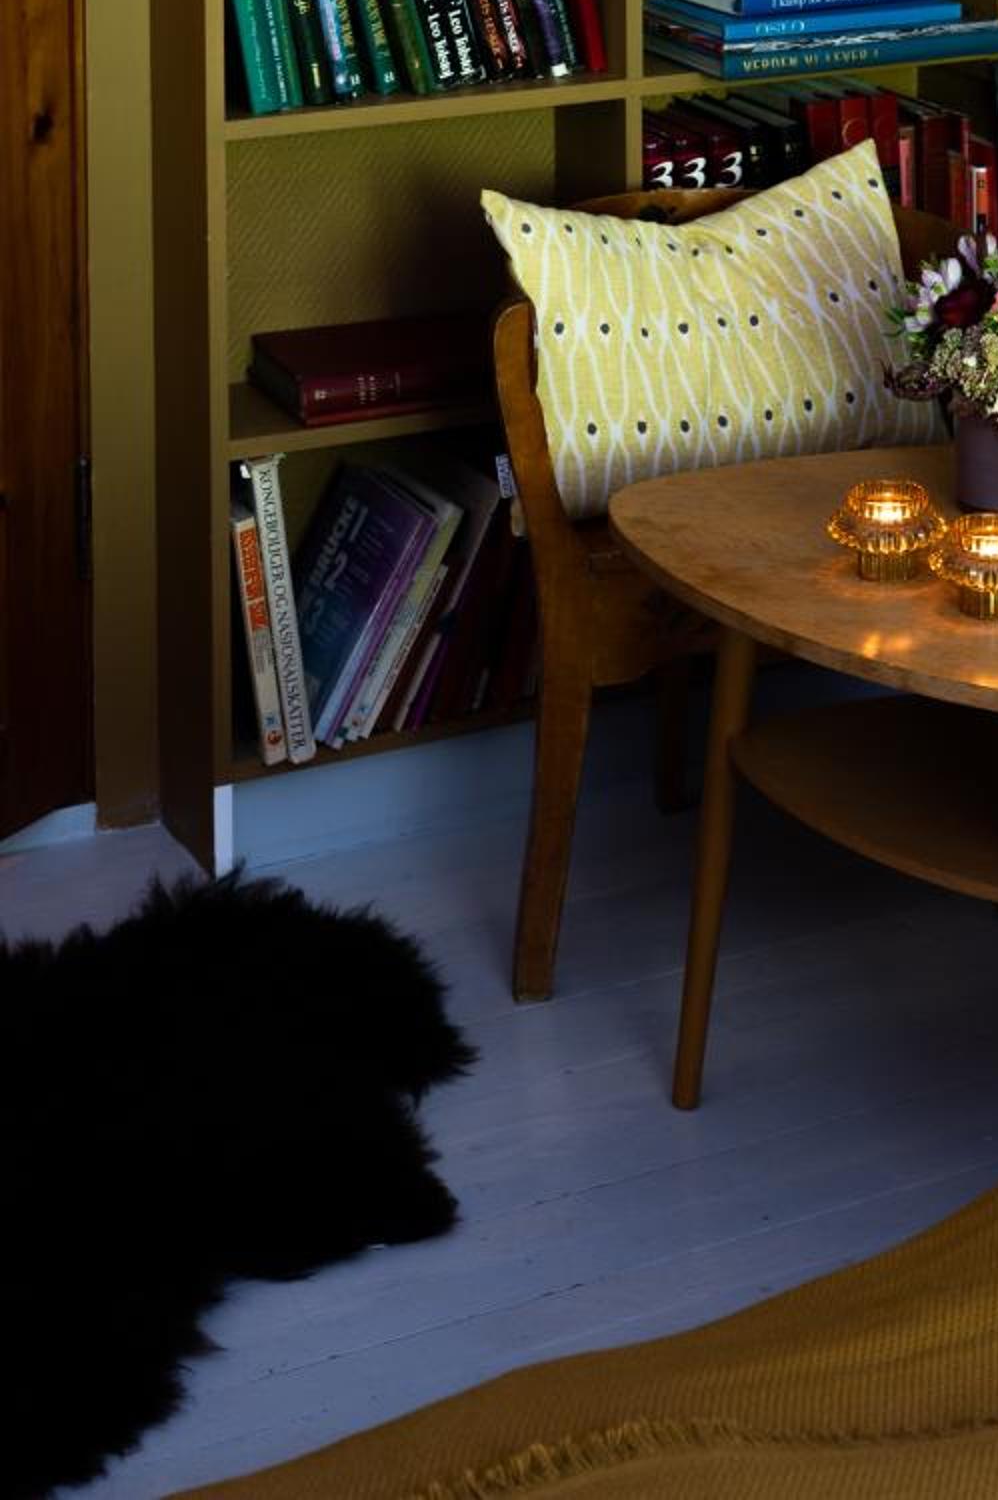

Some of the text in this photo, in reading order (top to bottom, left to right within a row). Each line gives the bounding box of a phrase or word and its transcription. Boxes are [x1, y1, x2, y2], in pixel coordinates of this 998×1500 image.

[427, 13, 443, 38] Leo
[448, 9, 465, 35] Leo
[430, 37, 454, 79] Tolstoj
[452, 34, 476, 76] Tolstoj
[742, 55, 799, 71] VERDEN
[804, 53, 819, 66] VI
[682, 156, 706, 188] 3
[715, 151, 742, 188] 3
[258, 469, 306, 748] KONGEBOLIGER OG NASJONALSKATTER
